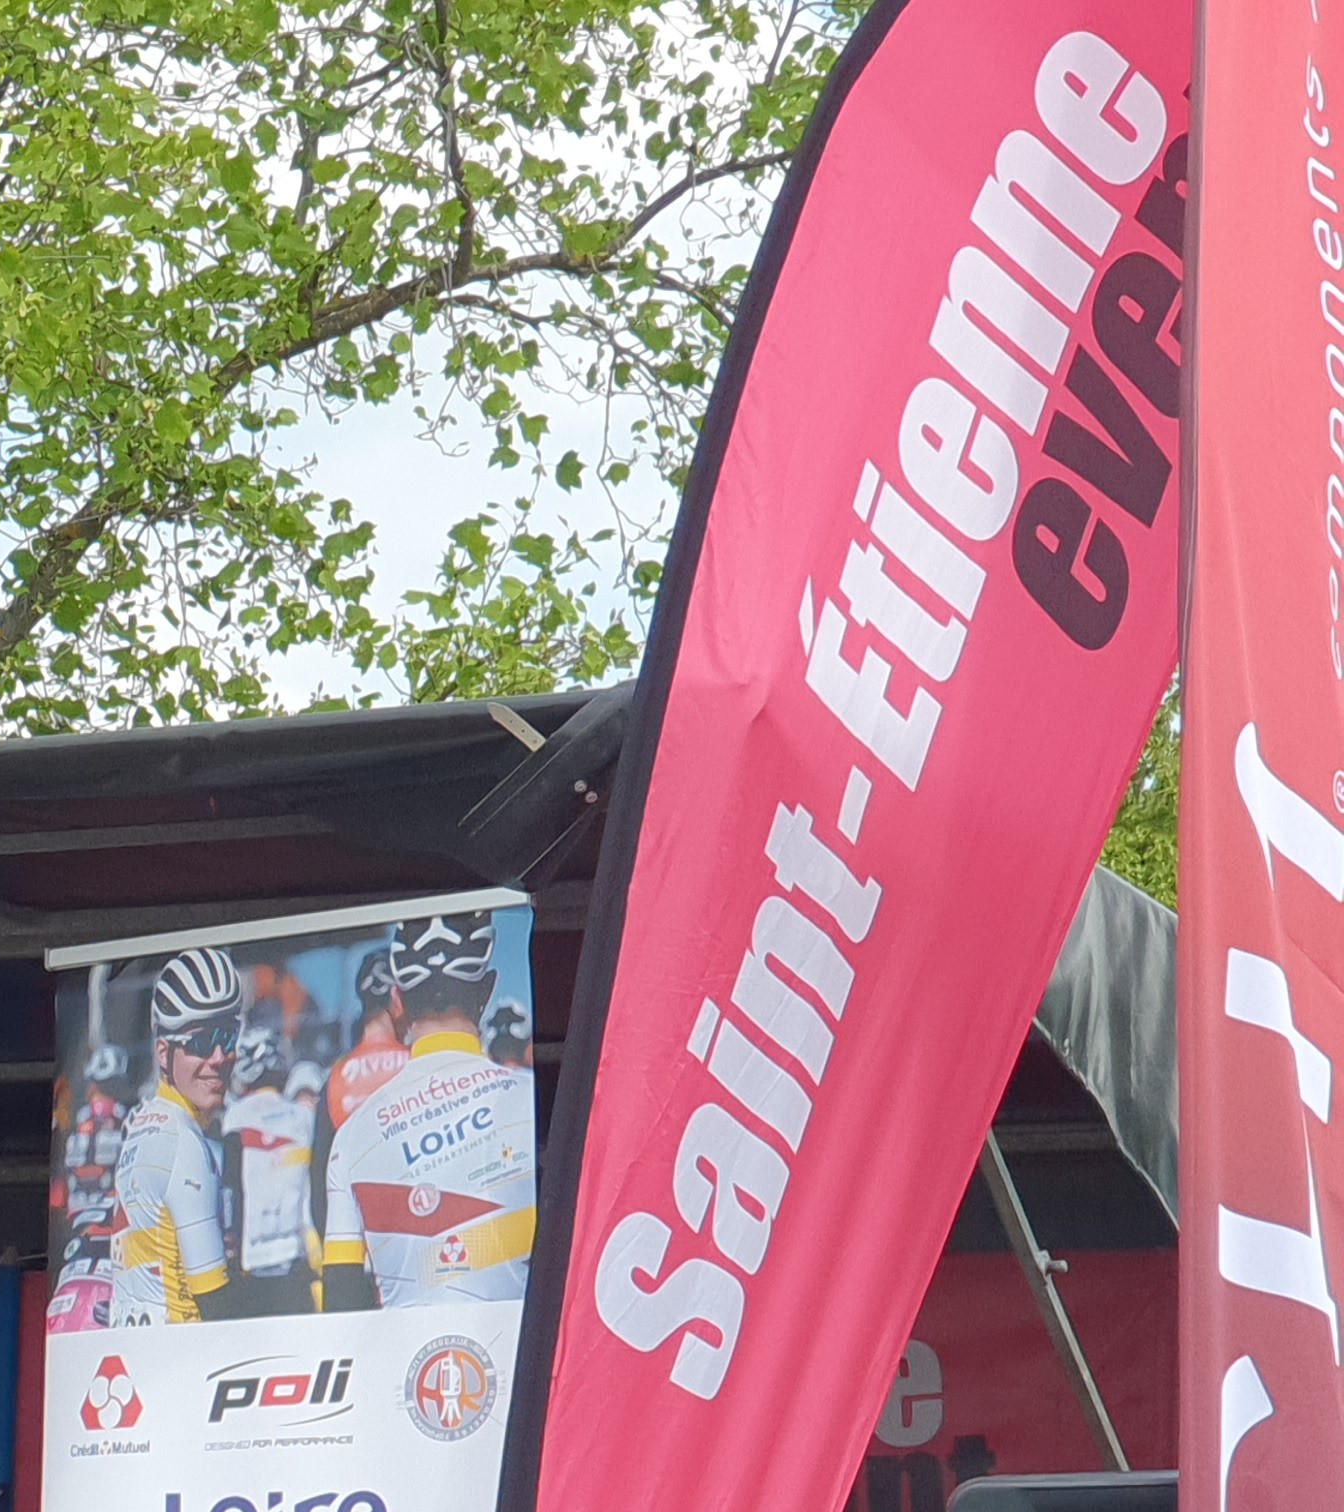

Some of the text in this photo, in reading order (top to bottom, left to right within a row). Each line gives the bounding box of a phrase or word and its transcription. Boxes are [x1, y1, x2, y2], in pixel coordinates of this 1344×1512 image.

[596, 31, 1168, 1400] Saint-Étienne
[381, 1120, 409, 1142] Ville
[410, 1094, 470, 1127] créative
[208, 1357, 355, 1424] poli
[69, 1439, 151, 1457] Crédit Mutuel
